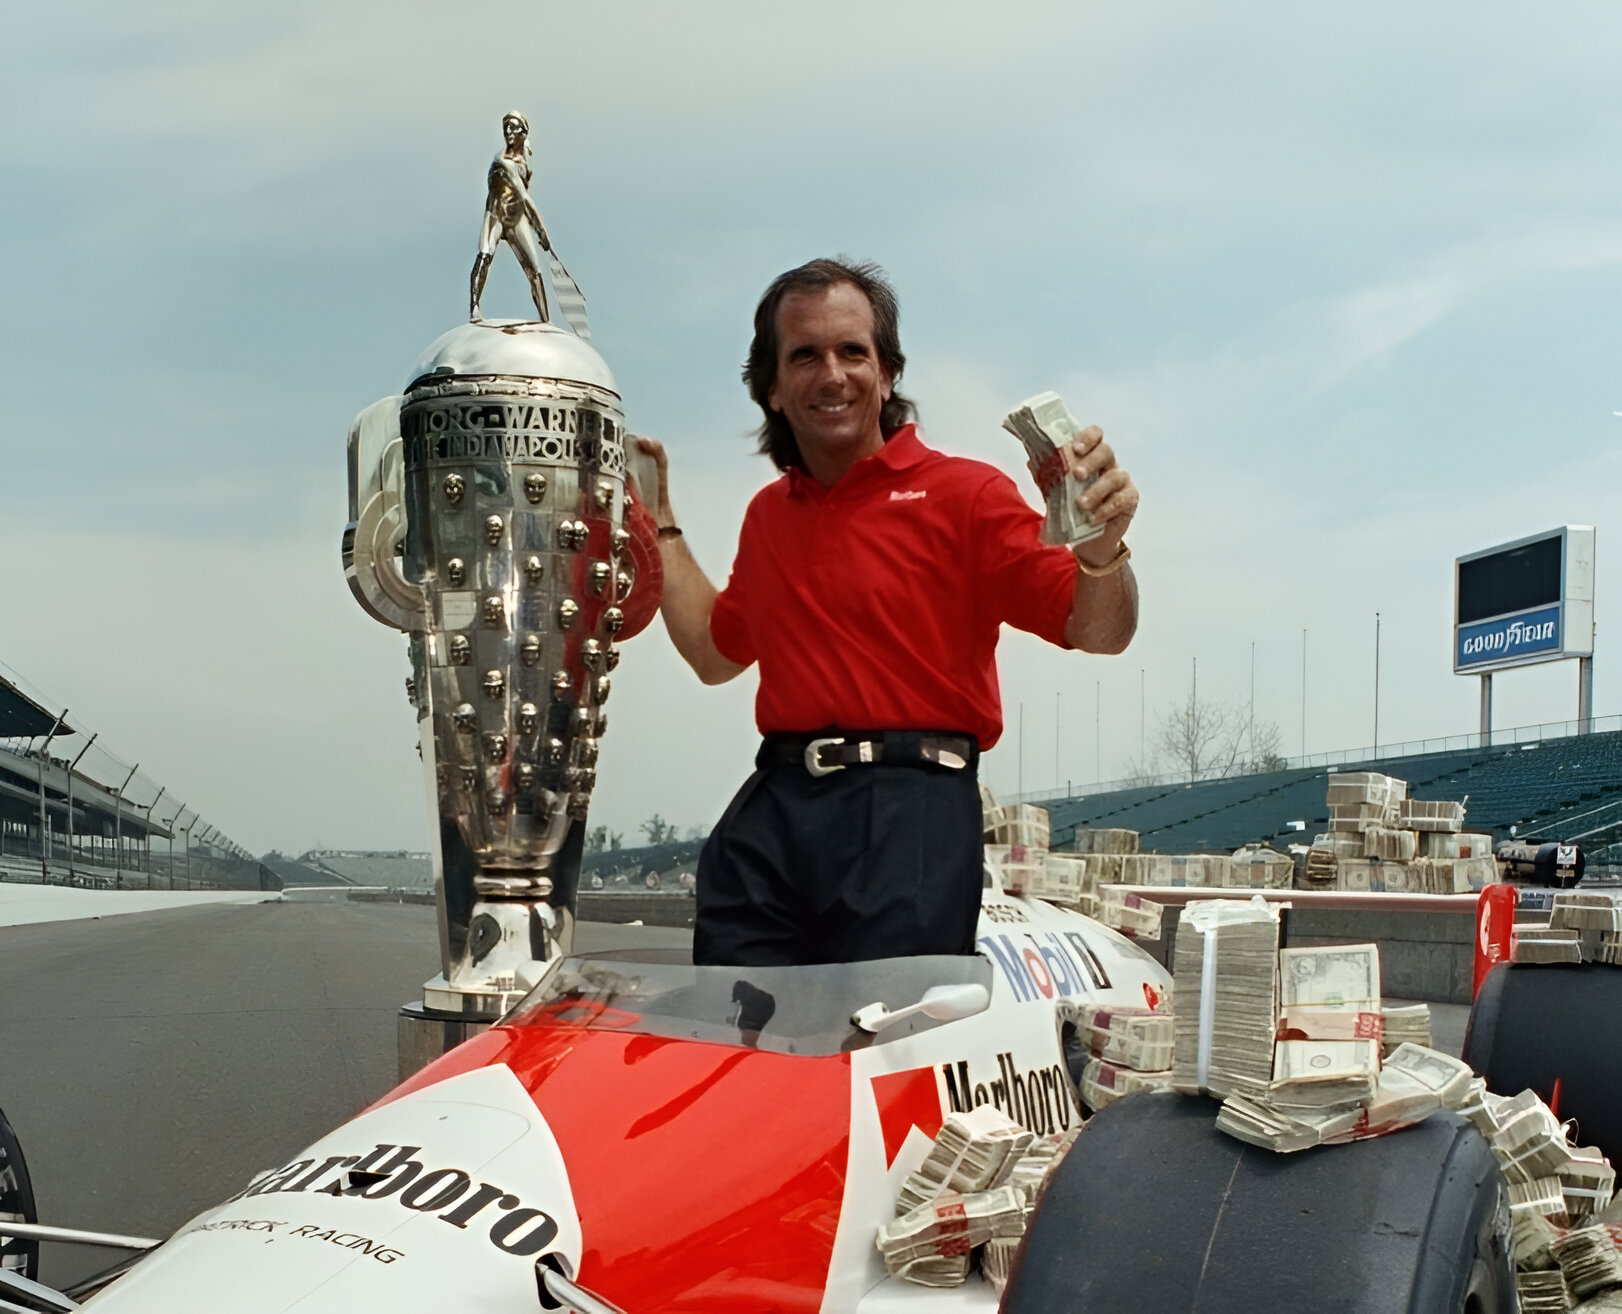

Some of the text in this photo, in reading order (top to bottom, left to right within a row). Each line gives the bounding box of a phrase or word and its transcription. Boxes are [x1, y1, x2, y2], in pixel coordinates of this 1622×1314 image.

[978, 932, 1087, 1003] Mobil
[228, 1143, 559, 1256] arlboro
[288, 1224, 405, 1264] RACING
